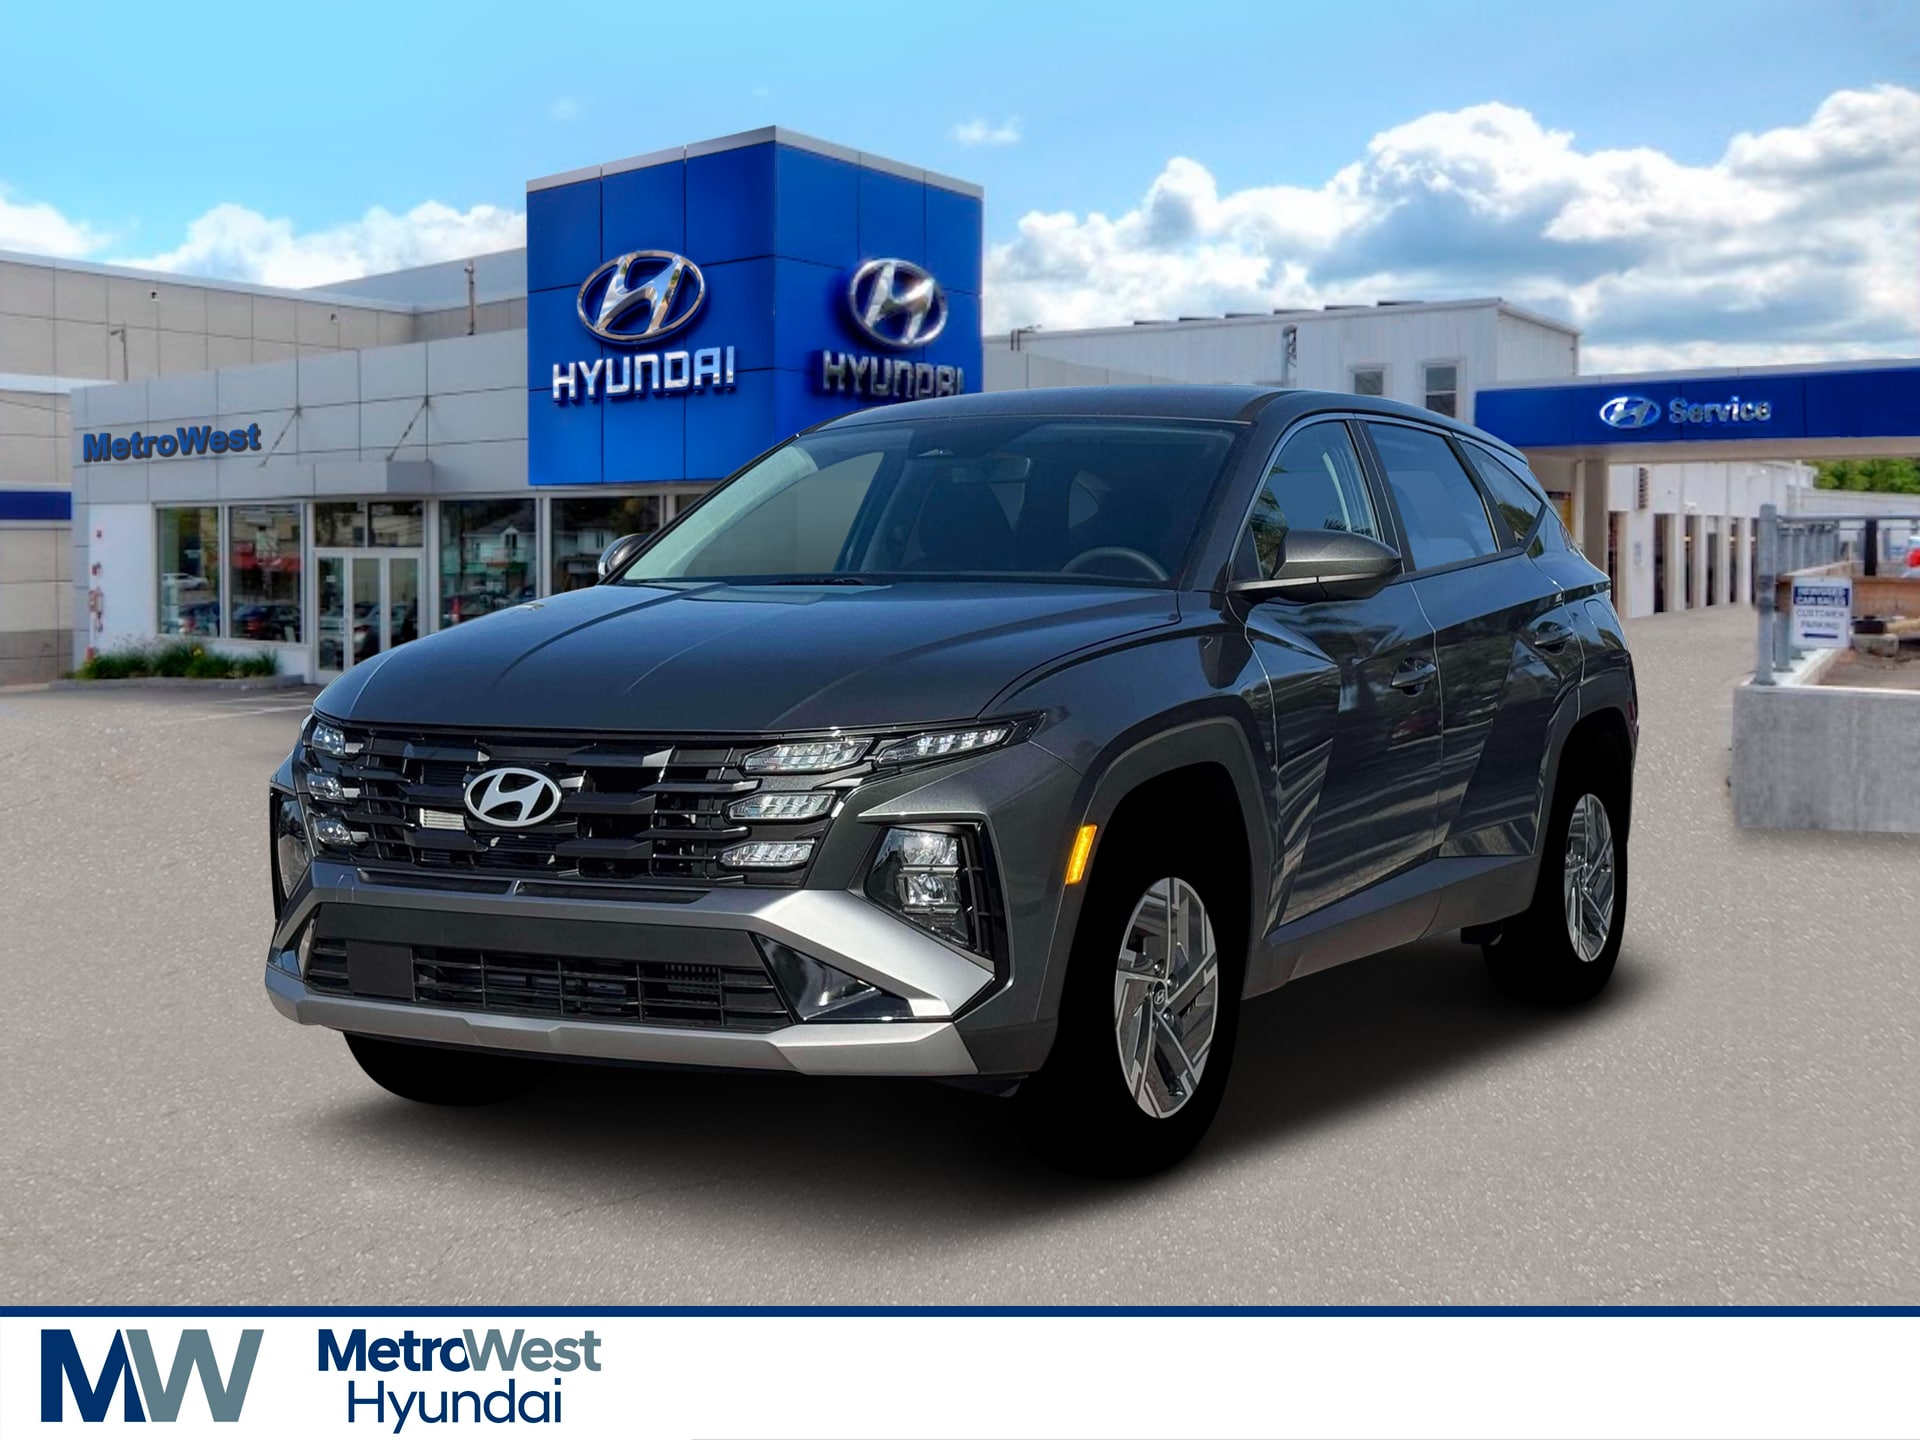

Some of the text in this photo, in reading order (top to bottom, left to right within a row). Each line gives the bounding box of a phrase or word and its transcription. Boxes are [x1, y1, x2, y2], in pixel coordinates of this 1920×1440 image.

[552, 345, 735, 399] HYUNDAI
[823, 350, 964, 398] HYUNDAI
[1668, 397, 1771, 423] Service
[83, 423, 262, 462] MetroWest
[1796, 609, 1845, 618] CUSTOMER
[1800, 620, 1840, 630] PARKING
